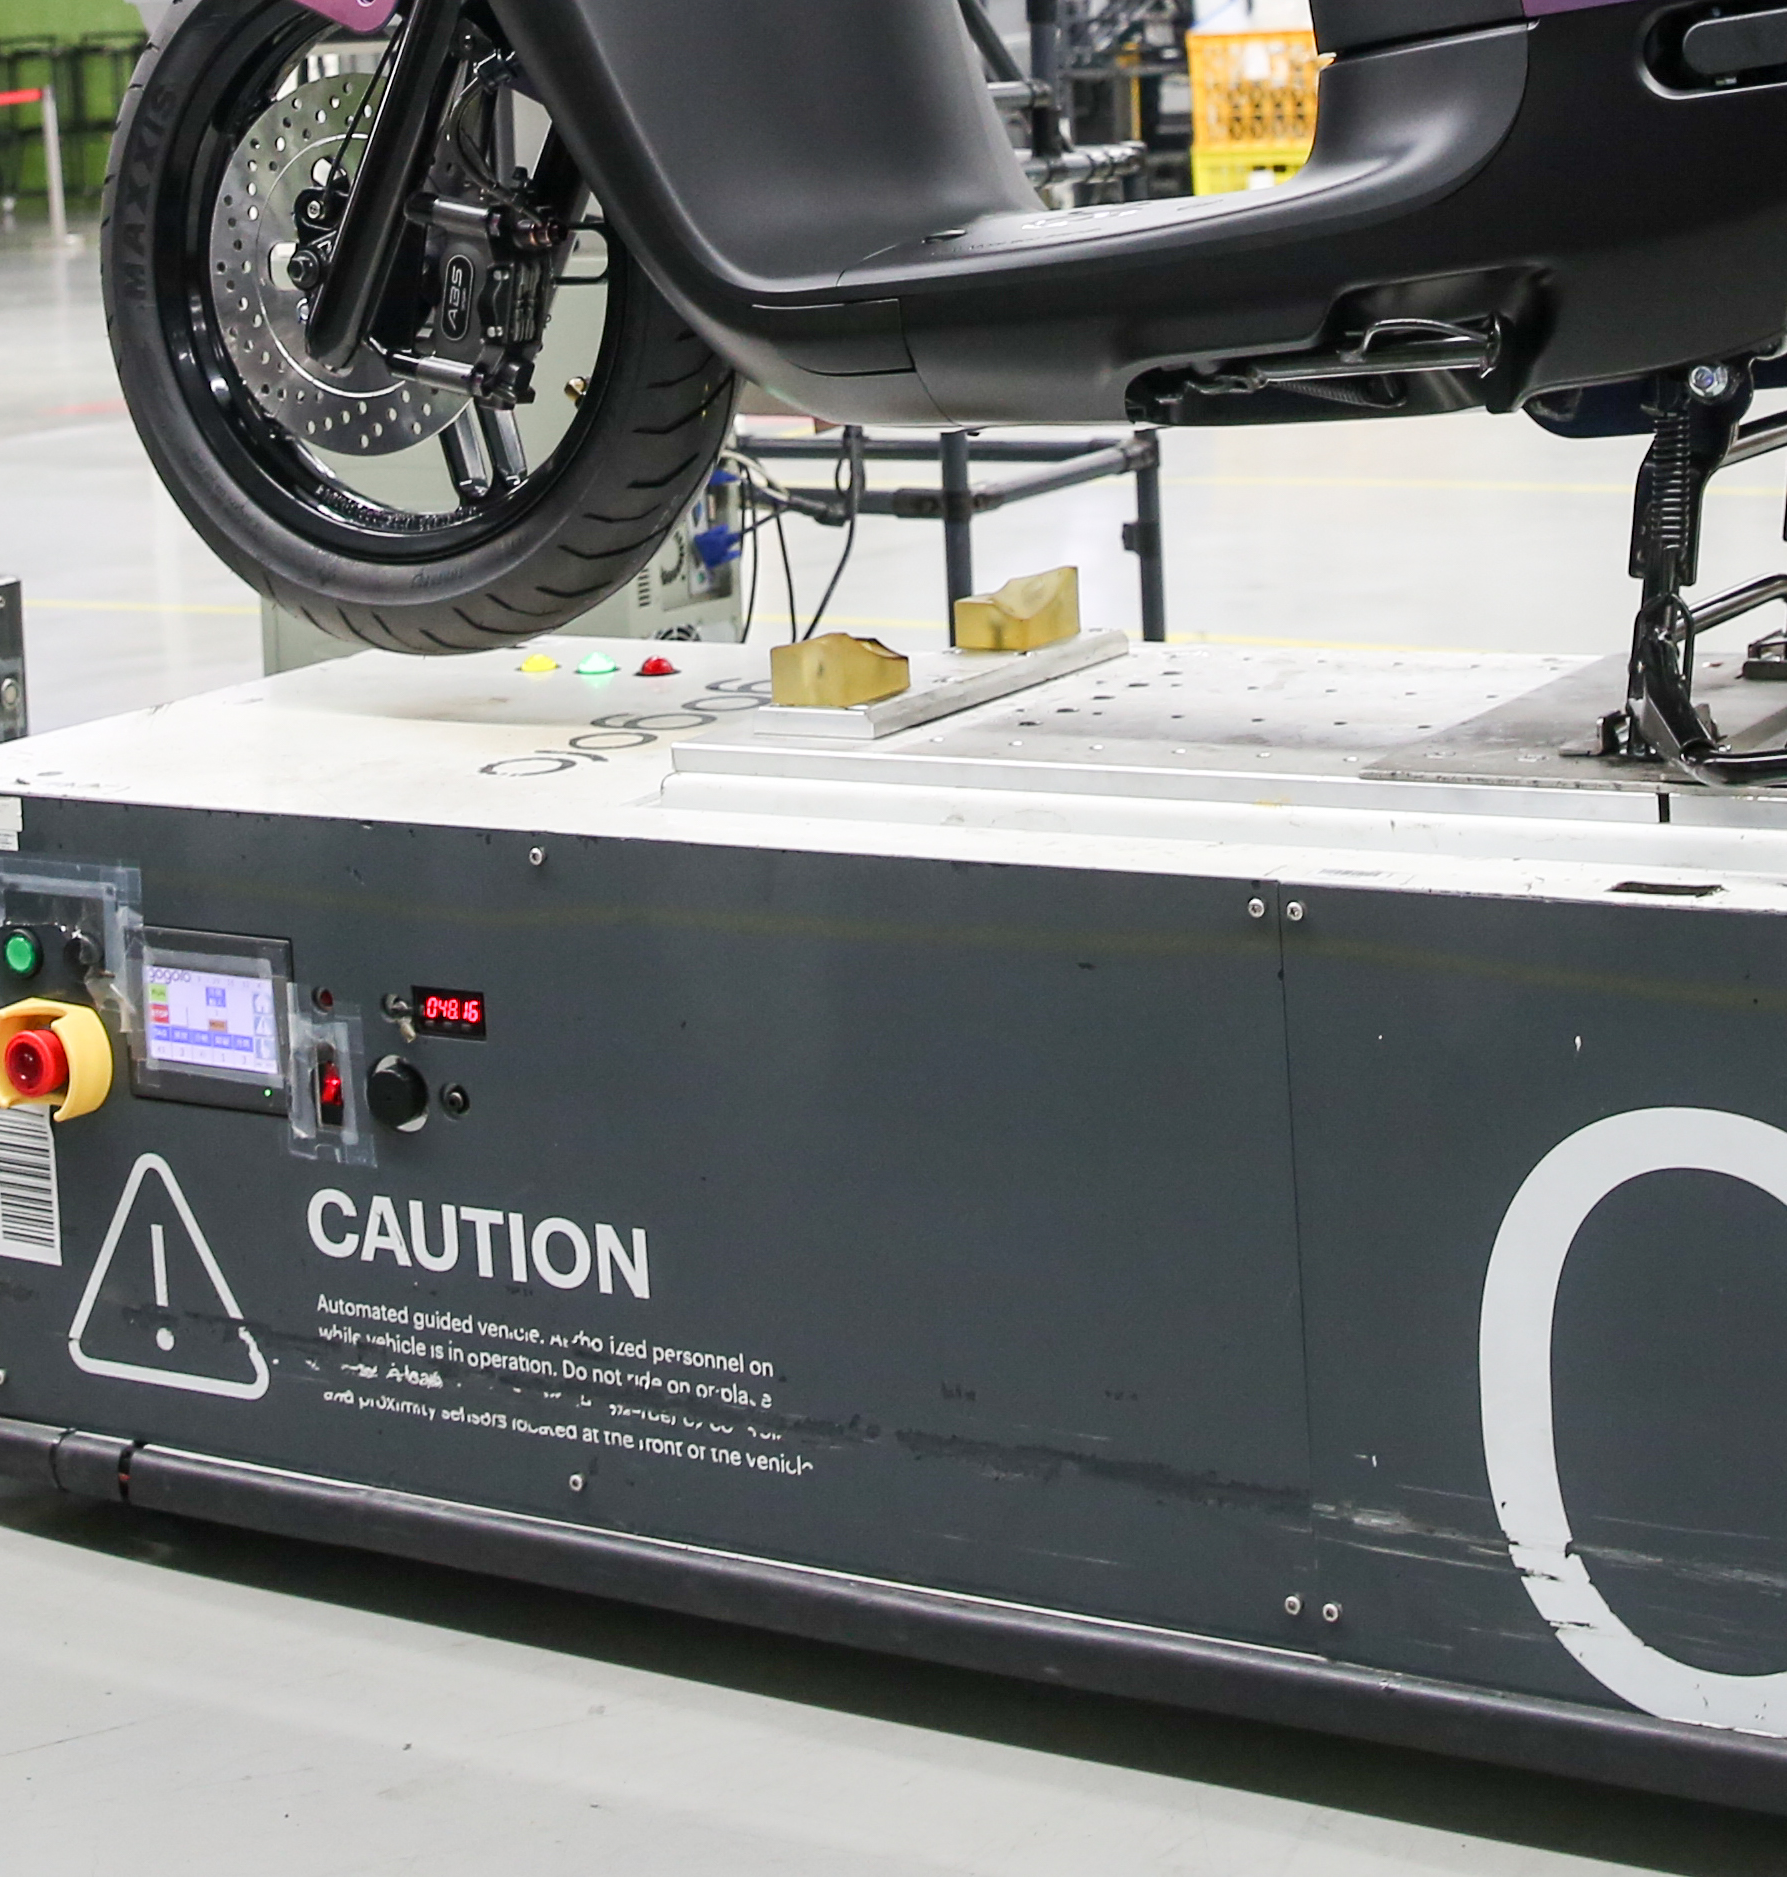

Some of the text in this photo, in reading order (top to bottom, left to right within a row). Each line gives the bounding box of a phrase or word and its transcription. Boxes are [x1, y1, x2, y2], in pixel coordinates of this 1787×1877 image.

[122, 83, 177, 300] MAXXIS
[447, 265, 463, 331] ABS
[307, 1188, 651, 1300] CAUTION
[317, 1293, 409, 1325] Automated
[413, 1310, 473, 1334] guided
[653, 1345, 745, 1374] personnel
[430, 1343, 445, 1360] is
[447, 1339, 465, 1363] in
[466, 1351, 558, 1378] operation.
[562, 1359, 589, 1382] Do
[592, 1368, 624, 1388] not
[667, 1378, 691, 1396] on
[582, 1426, 601, 1444] at
